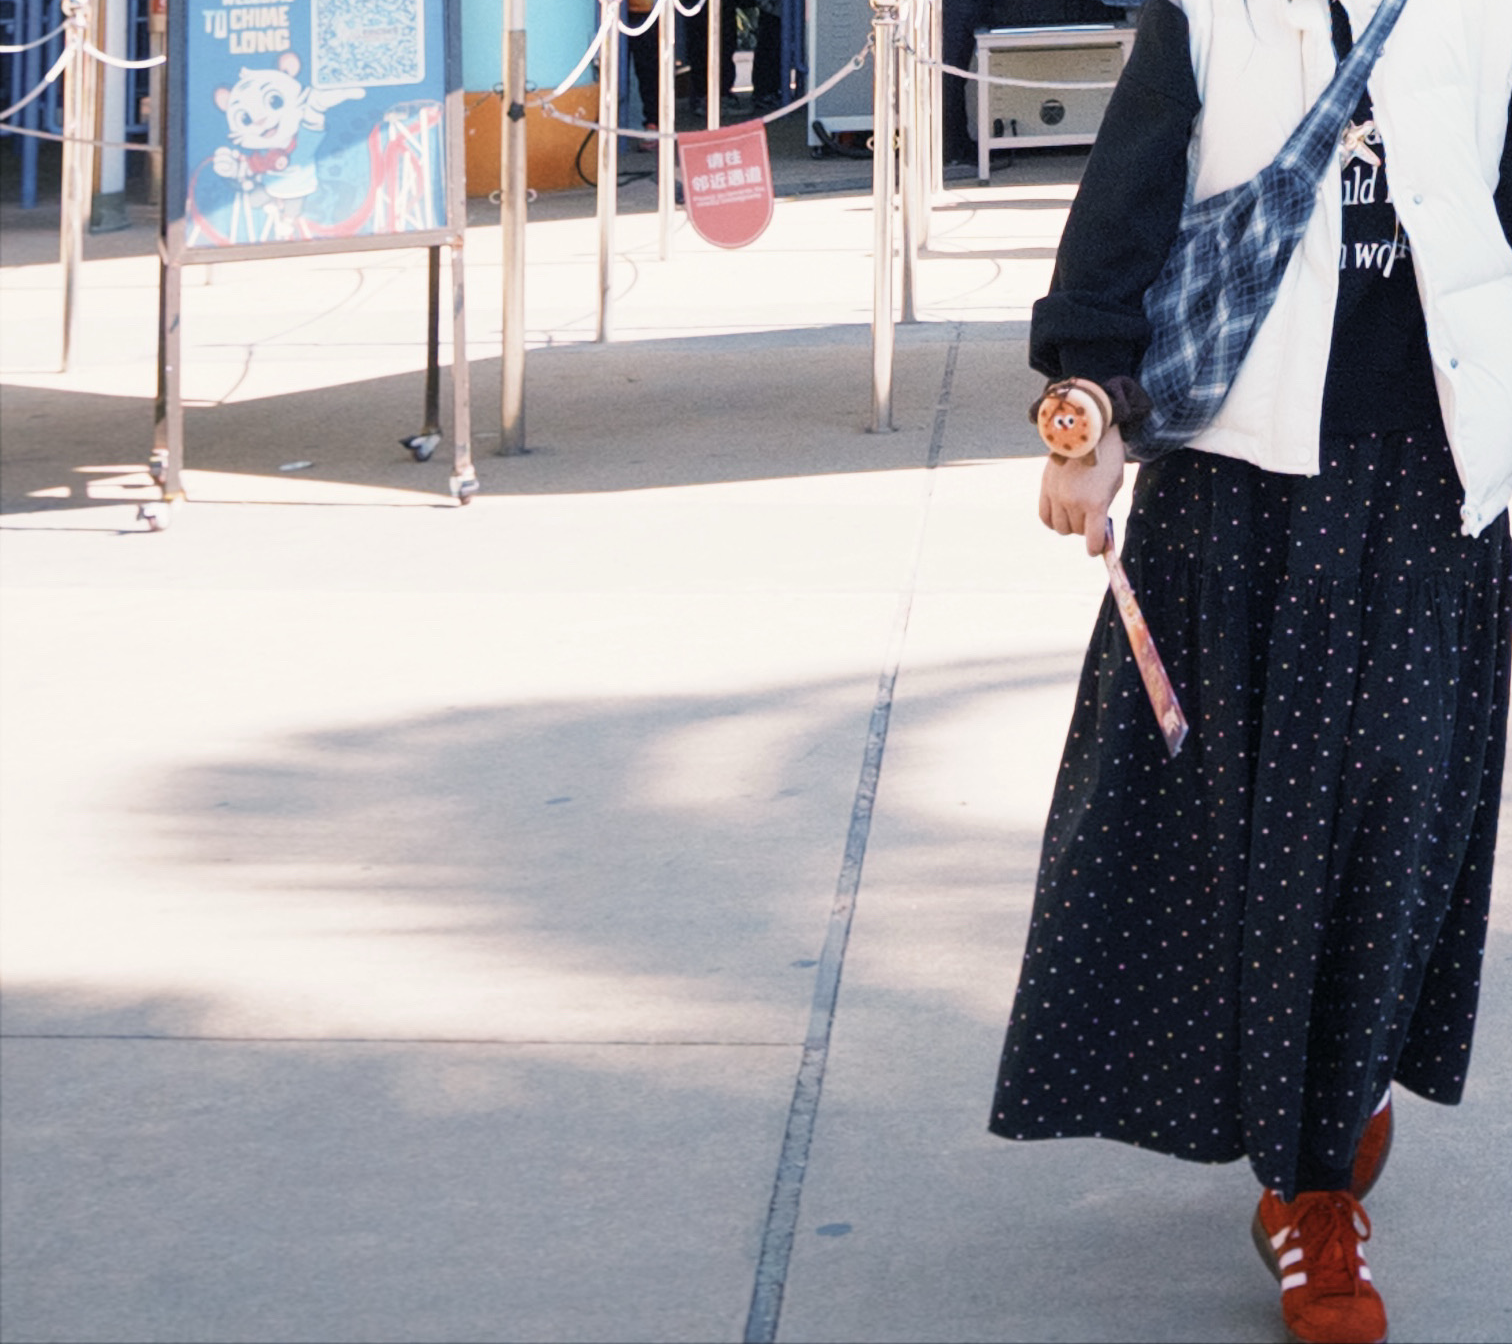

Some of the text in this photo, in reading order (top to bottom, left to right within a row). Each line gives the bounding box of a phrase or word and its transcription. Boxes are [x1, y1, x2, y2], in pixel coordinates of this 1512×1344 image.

[202, 5, 291, 40] TO CHIME
[228, 28, 291, 55] LONG
